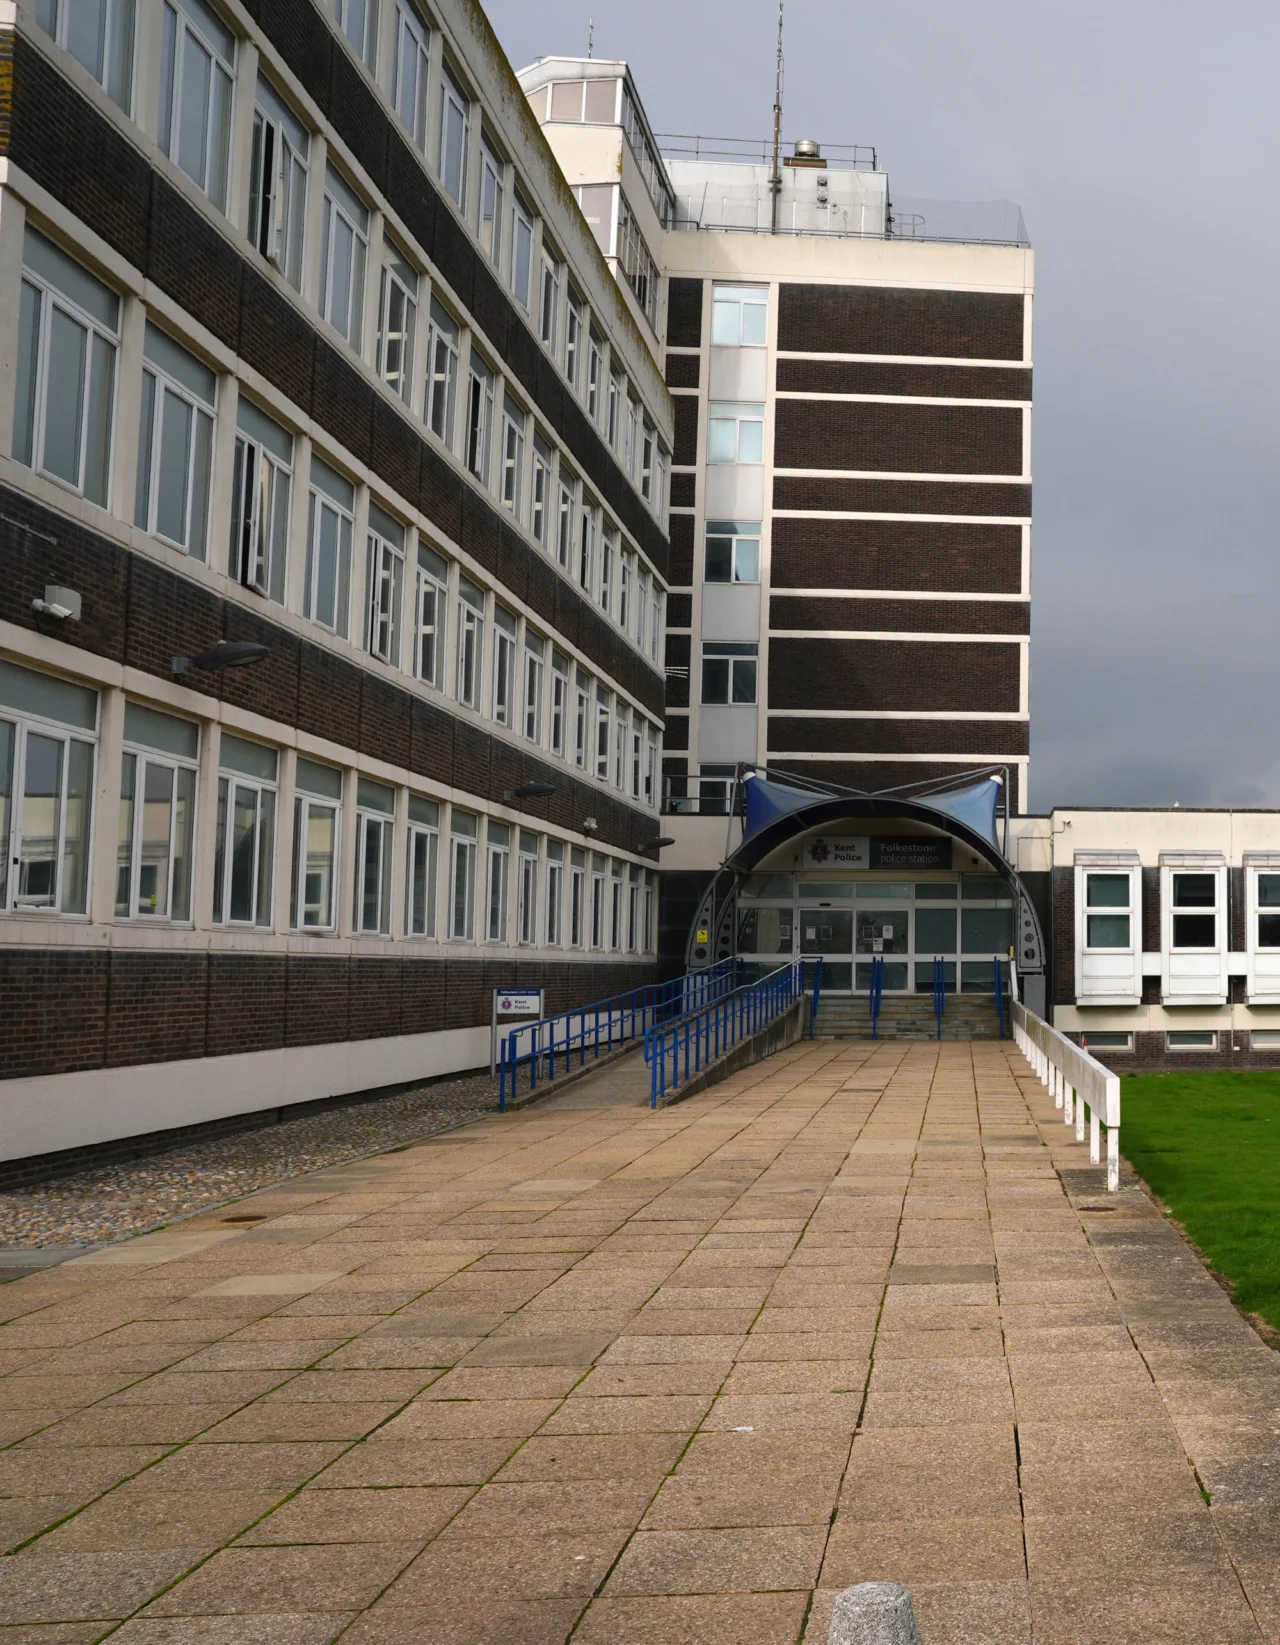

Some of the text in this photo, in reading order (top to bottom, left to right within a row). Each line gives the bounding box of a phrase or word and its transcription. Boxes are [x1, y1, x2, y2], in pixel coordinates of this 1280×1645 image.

[834, 844, 856, 852] Kent
[880, 843, 937, 852] Folkestone
[834, 853, 862, 862] Police
[880, 853, 939, 864] polce station
